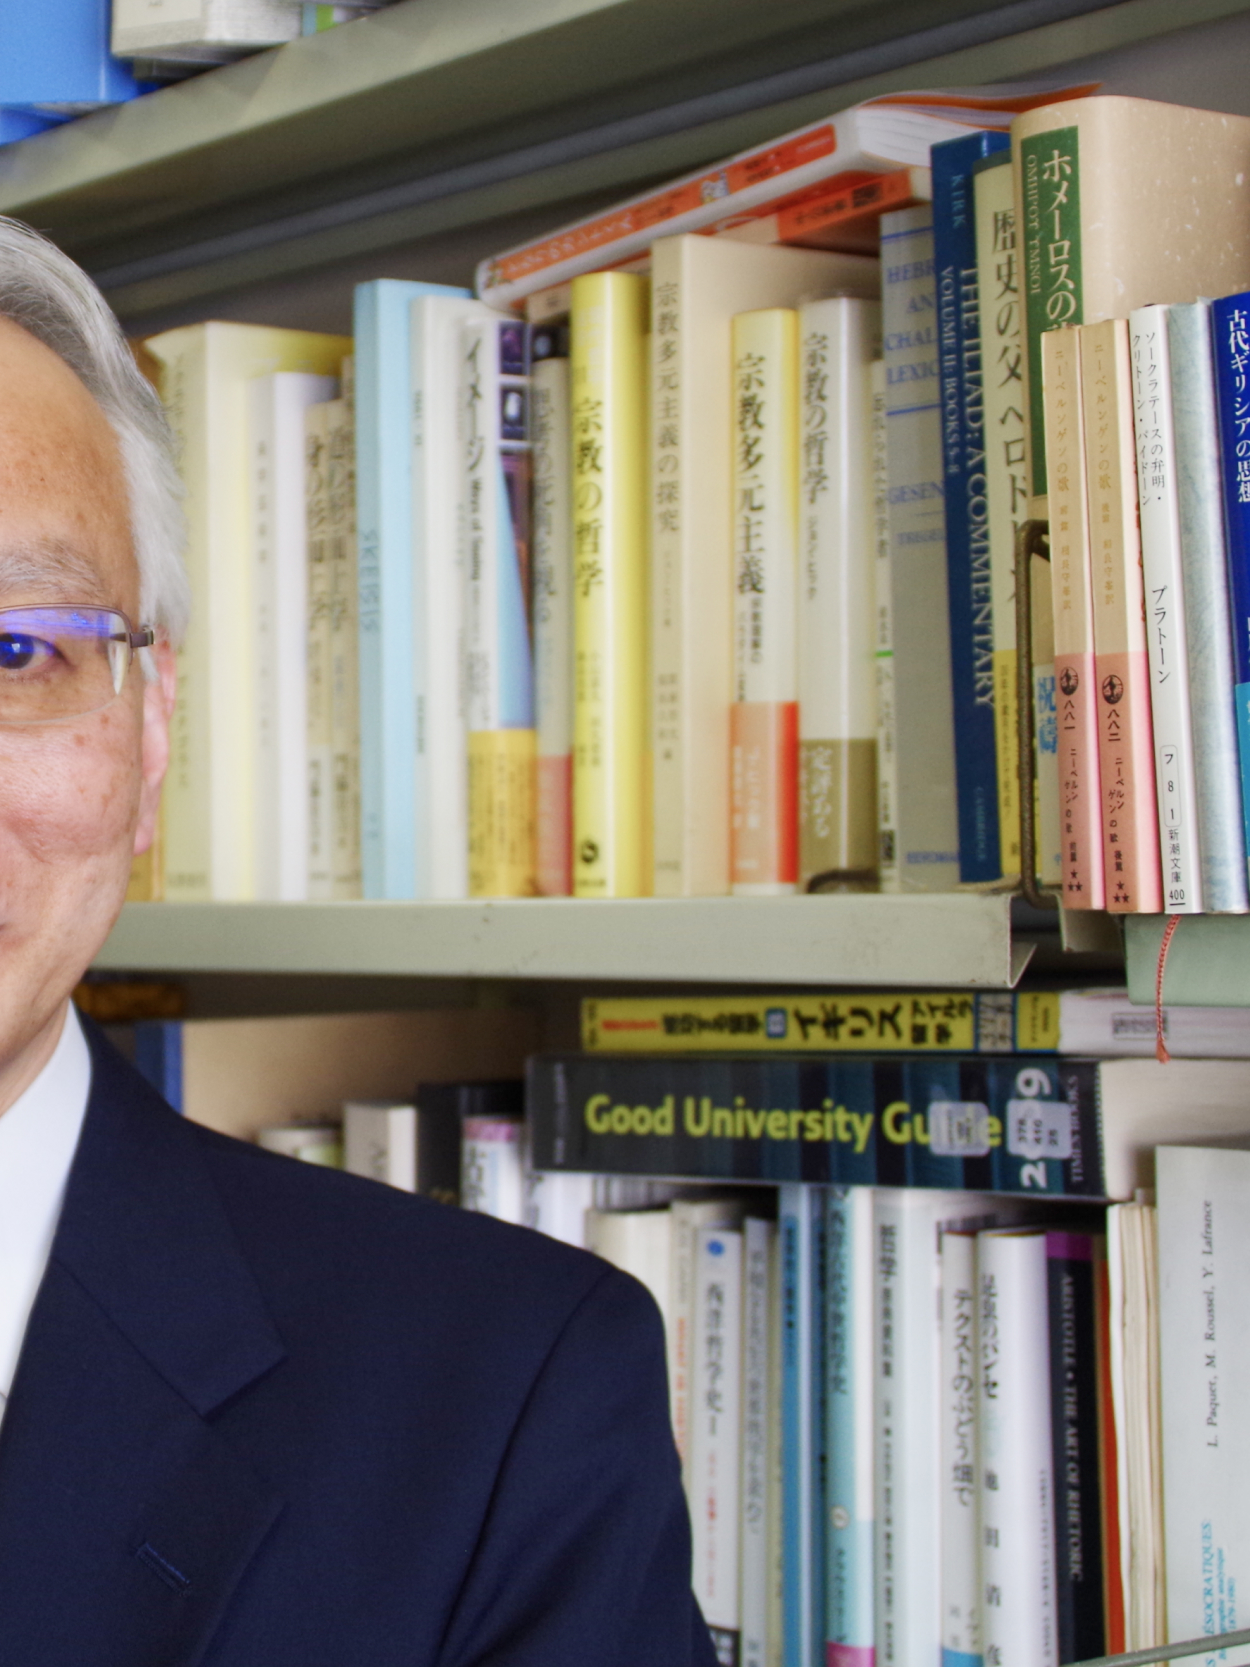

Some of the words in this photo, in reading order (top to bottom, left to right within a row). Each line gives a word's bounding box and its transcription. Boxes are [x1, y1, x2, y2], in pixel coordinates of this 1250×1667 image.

[952, 174, 966, 228] KIRK
[1042, 150, 1077, 331] ホメーロスの
[906, 293, 936, 313] AN
[941, 265, 957, 349] VOLUME
[959, 267, 980, 330] THE
[992, 208, 1022, 389] 歴史の父
[467, 337, 485, 472] イメージ
[655, 281, 680, 534] 宗教多元主義の探究
[804, 332, 830, 504] 宗教の哲学
[944, 377, 960, 443] BOOKS
[1054, 351, 1070, 493] ニーベルンゲンの歌
[1095, 345, 1112, 490] ニーベルンゲンの歌
[1132, 334, 1150, 507] クリトーン・パイドーン
[1226, 309, 1250, 503] 古代ギリシアの思想
[574, 396, 603, 598] 宗教の哲学
[735, 353, 766, 595] 宗教多元主義
[966, 446, 987, 469] A
[966, 473, 994, 707] COMMENTARY
[1152, 585, 1171, 684] プラトーン
[1168, 780, 1174, 792] 8
[1168, 829, 1182, 884] 新潮文庫
[1169, 889, 1185, 901] 400
[793, 1002, 903, 1041] イギリス
[585, 1094, 675, 1136] Good
[684, 1096, 874, 1153] University
[881, 1102, 1002, 1148] Gue
[1017, 1067, 1052, 1190] 29
[1202, 1200, 1214, 1256] Lafrance
[1203, 1262, 1214, 1279] Y.
[1061, 1272, 1076, 1367] ARISTOTLE
[1205, 1350, 1217, 1368] M.
[1063, 1385, 1078, 1420] THE
[1065, 1423, 1080, 1458] ART
[1207, 1434, 1218, 1448] L.
[1065, 1461, 1081, 1486] OF
[1066, 1489, 1084, 1582] RHETORIC
[1201, 1520, 1216, 1653] ÉSOCRATIQUES
